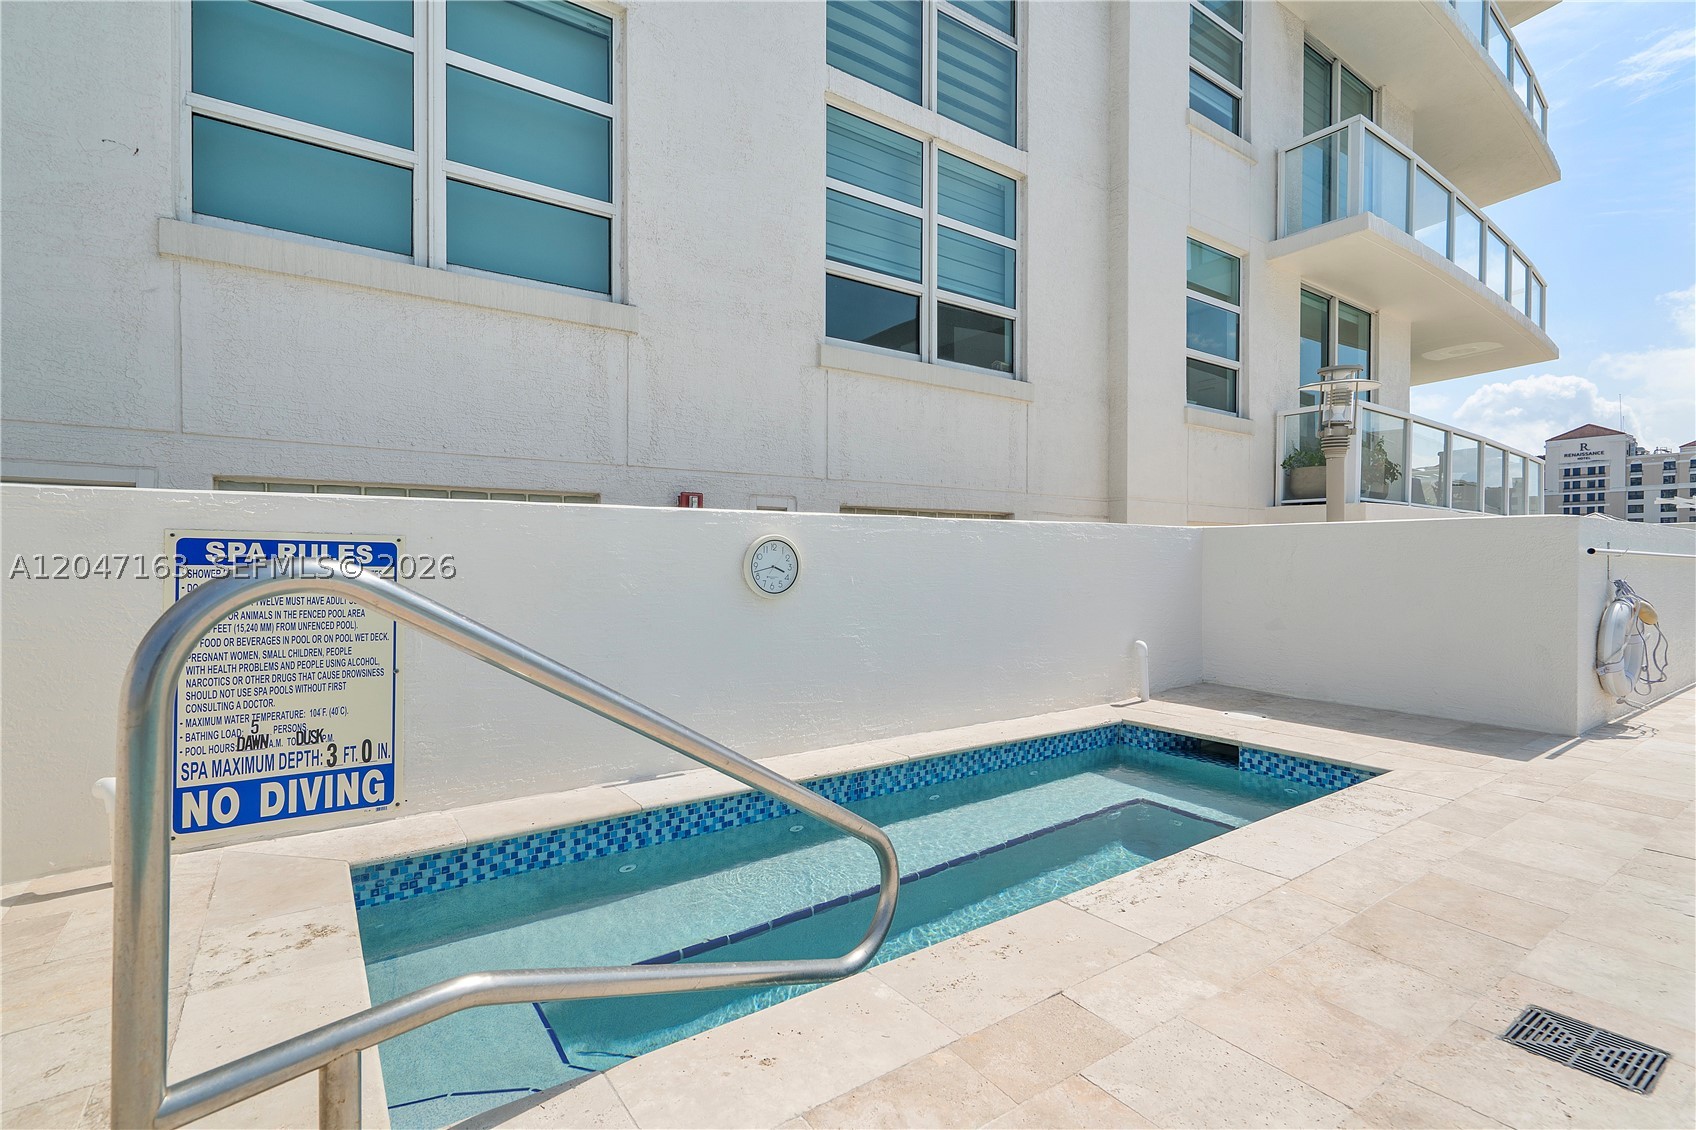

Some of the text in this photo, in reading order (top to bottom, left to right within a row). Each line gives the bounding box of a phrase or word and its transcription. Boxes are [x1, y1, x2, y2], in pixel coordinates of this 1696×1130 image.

[1580, 443, 1591, 451] R
[205, 541, 373, 564] SPA RULES
[286, 596, 305, 605] MUST
[306, 596, 325, 605] HAVE
[240, 610, 273, 620] ANIMALS
[274, 610, 282, 619] IN
[283, 610, 297, 619] THE
[299, 609, 326, 619] FENCED
[328, 609, 346, 618] POOL
[347, 608, 366, 618] AREA
[233, 623, 258, 635] (15,240
[260, 622, 275, 633] MM)
[276, 621, 296, 632] FROM
[298, 620, 335, 631] UNFENCED
[336, 620, 359, 631] POOL).
[200, 632, 389, 648] FOOD OR BEVERAGES IN POOL OR ON POOL WET DECK.
[229, 651, 261, 661] WOMEN,
[262, 649, 287, 659] SMALL
[287, 648, 325, 658] CHILDREN,
[325, 646, 352, 656] PEOPLE
[186, 665, 206, 675] WITH
[207, 664, 237, 674] HEALTH
[238, 662, 279, 673] PROBLEMS
[280, 660, 296, 670] AND
[296, 660, 324, 669] PEOPLE
[325, 658, 349, 668] USING
[185, 667, 385, 688] NARCOTICS OR OTHER DRUGS THAT CAUSE DROWSINESS
[185, 681, 347, 701] SHOULD NOT USE SPA POOLS WITHOUT FIRST
[185, 698, 275, 713] CONSULTING A DOCTOR.
[185, 716, 223, 728] MAXIMUM
[223, 713, 250, 725] WATER
[251, 709, 306, 721] TEMPERATURE:
[185, 730, 219, 742] BATHING
[250, 719, 260, 734] 5
[185, 746, 207, 757] POOL
[236, 733, 270, 752] DAWN
[268, 738, 284, 748] A.M.
[286, 737, 297, 746] TO
[296, 728, 324, 746] DUSK
[322, 733, 335, 743] P.M.
[181, 739, 391, 781] SPA MAXIMUM DEPTH: 3 FT. 0 IN.
[181, 768, 385, 829] NO DIVING
